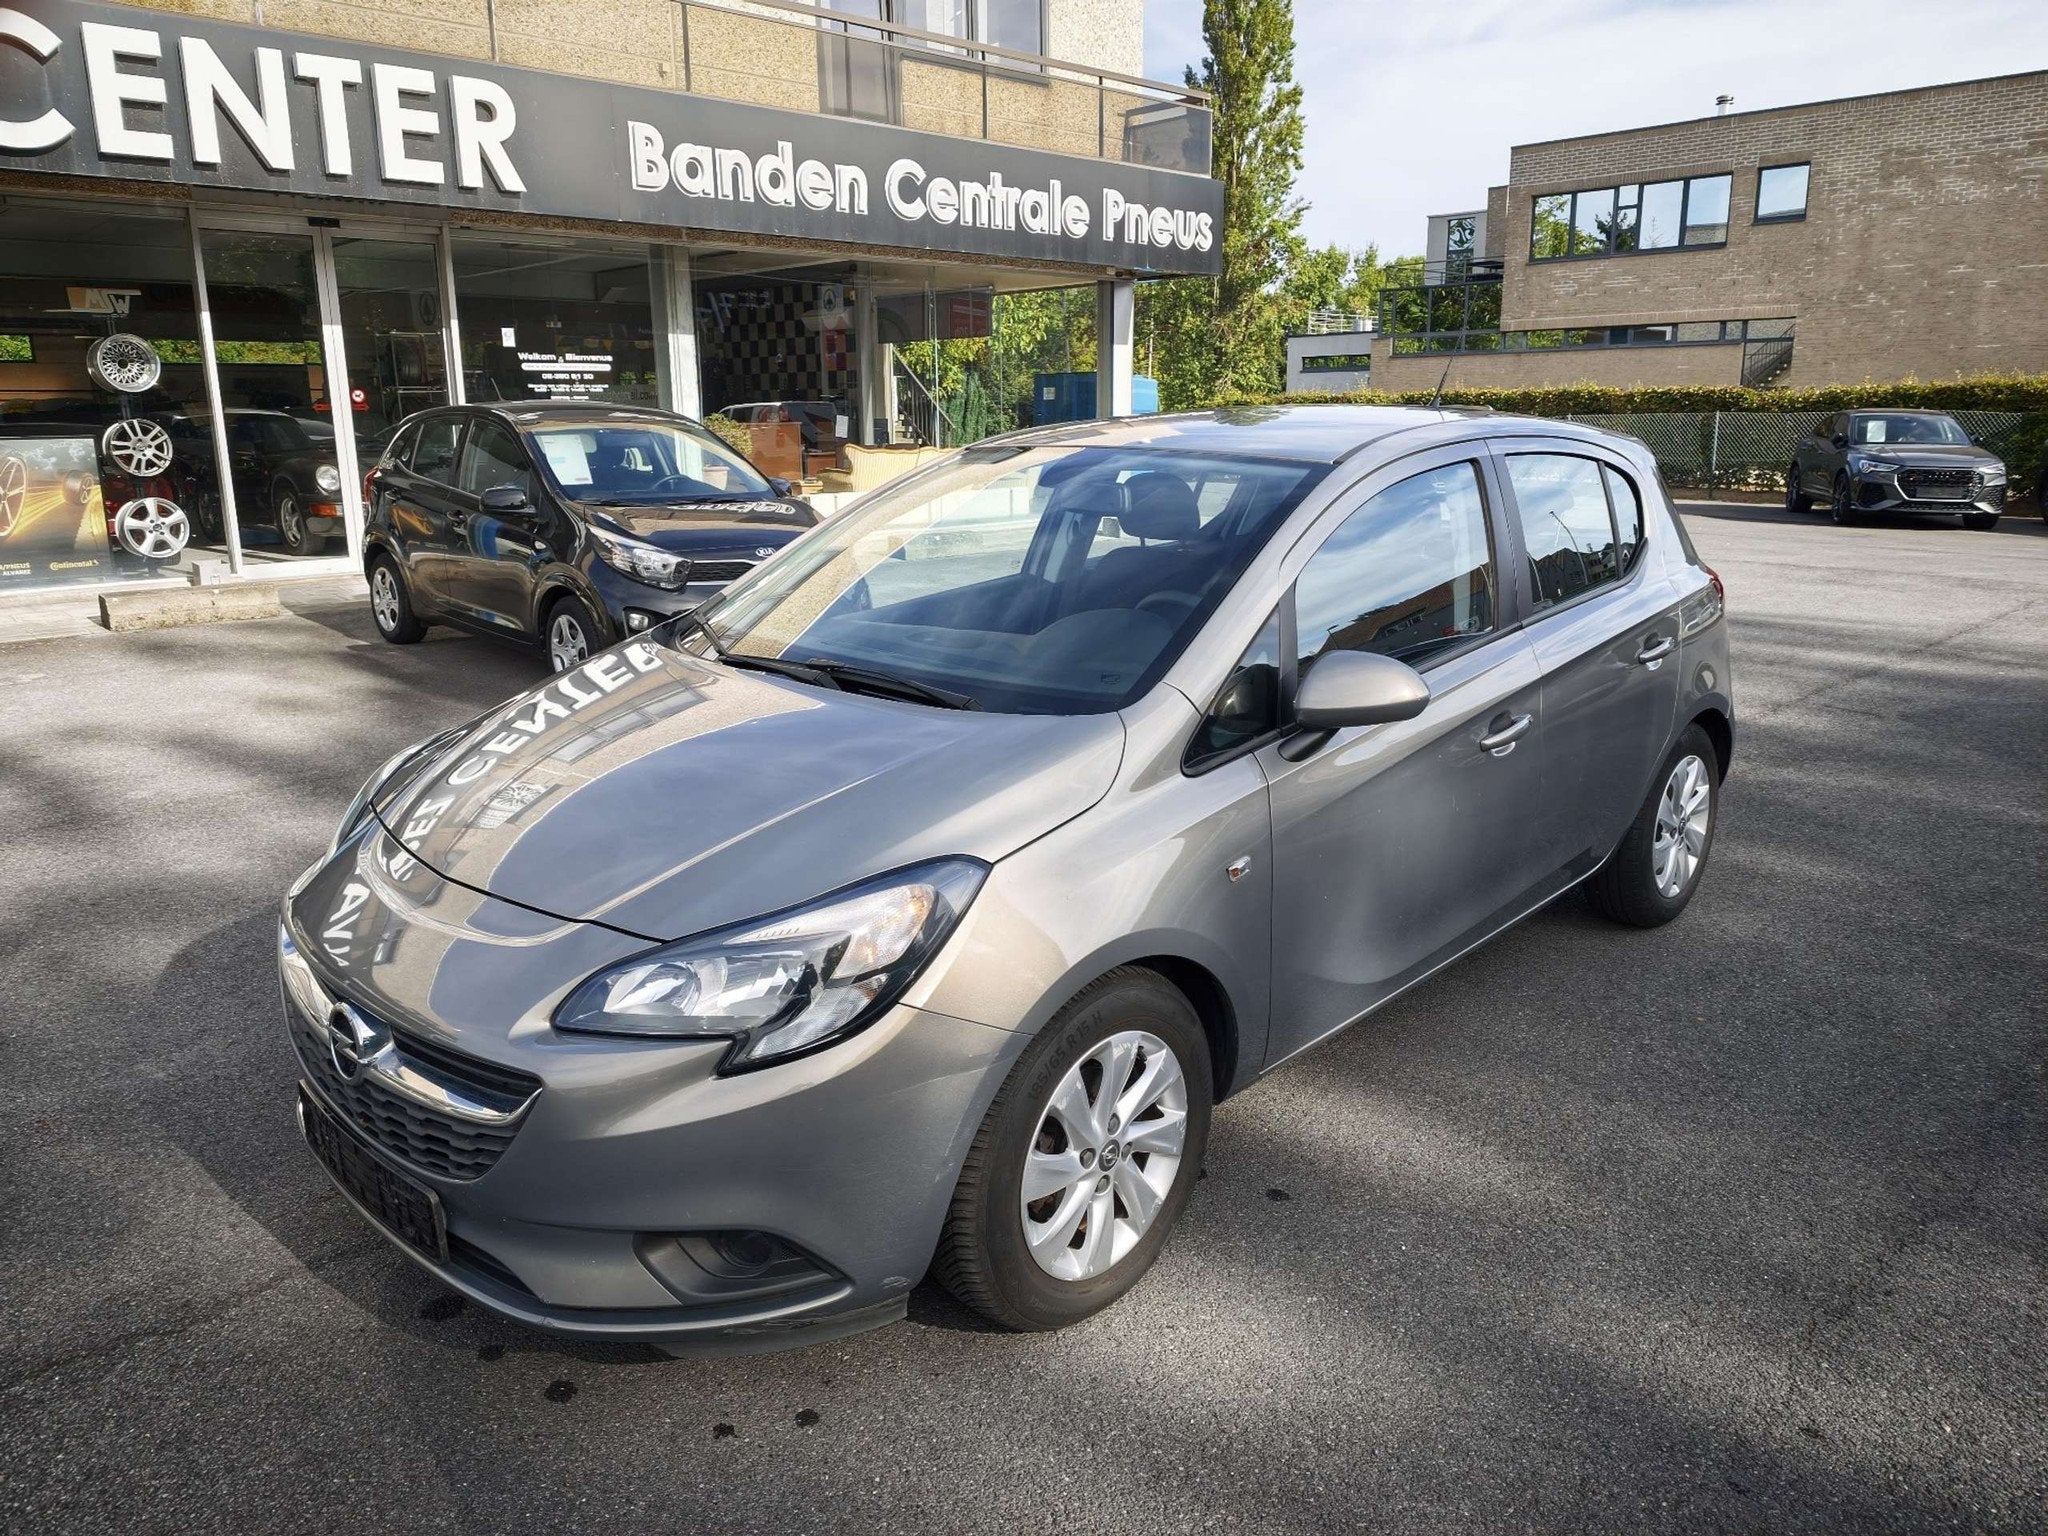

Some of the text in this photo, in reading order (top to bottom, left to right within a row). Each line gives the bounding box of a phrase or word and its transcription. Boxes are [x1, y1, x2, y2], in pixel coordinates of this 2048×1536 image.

[0, 7, 527, 193] CENTER
[627, 120, 1212, 252] Banden Centrale Pneus
